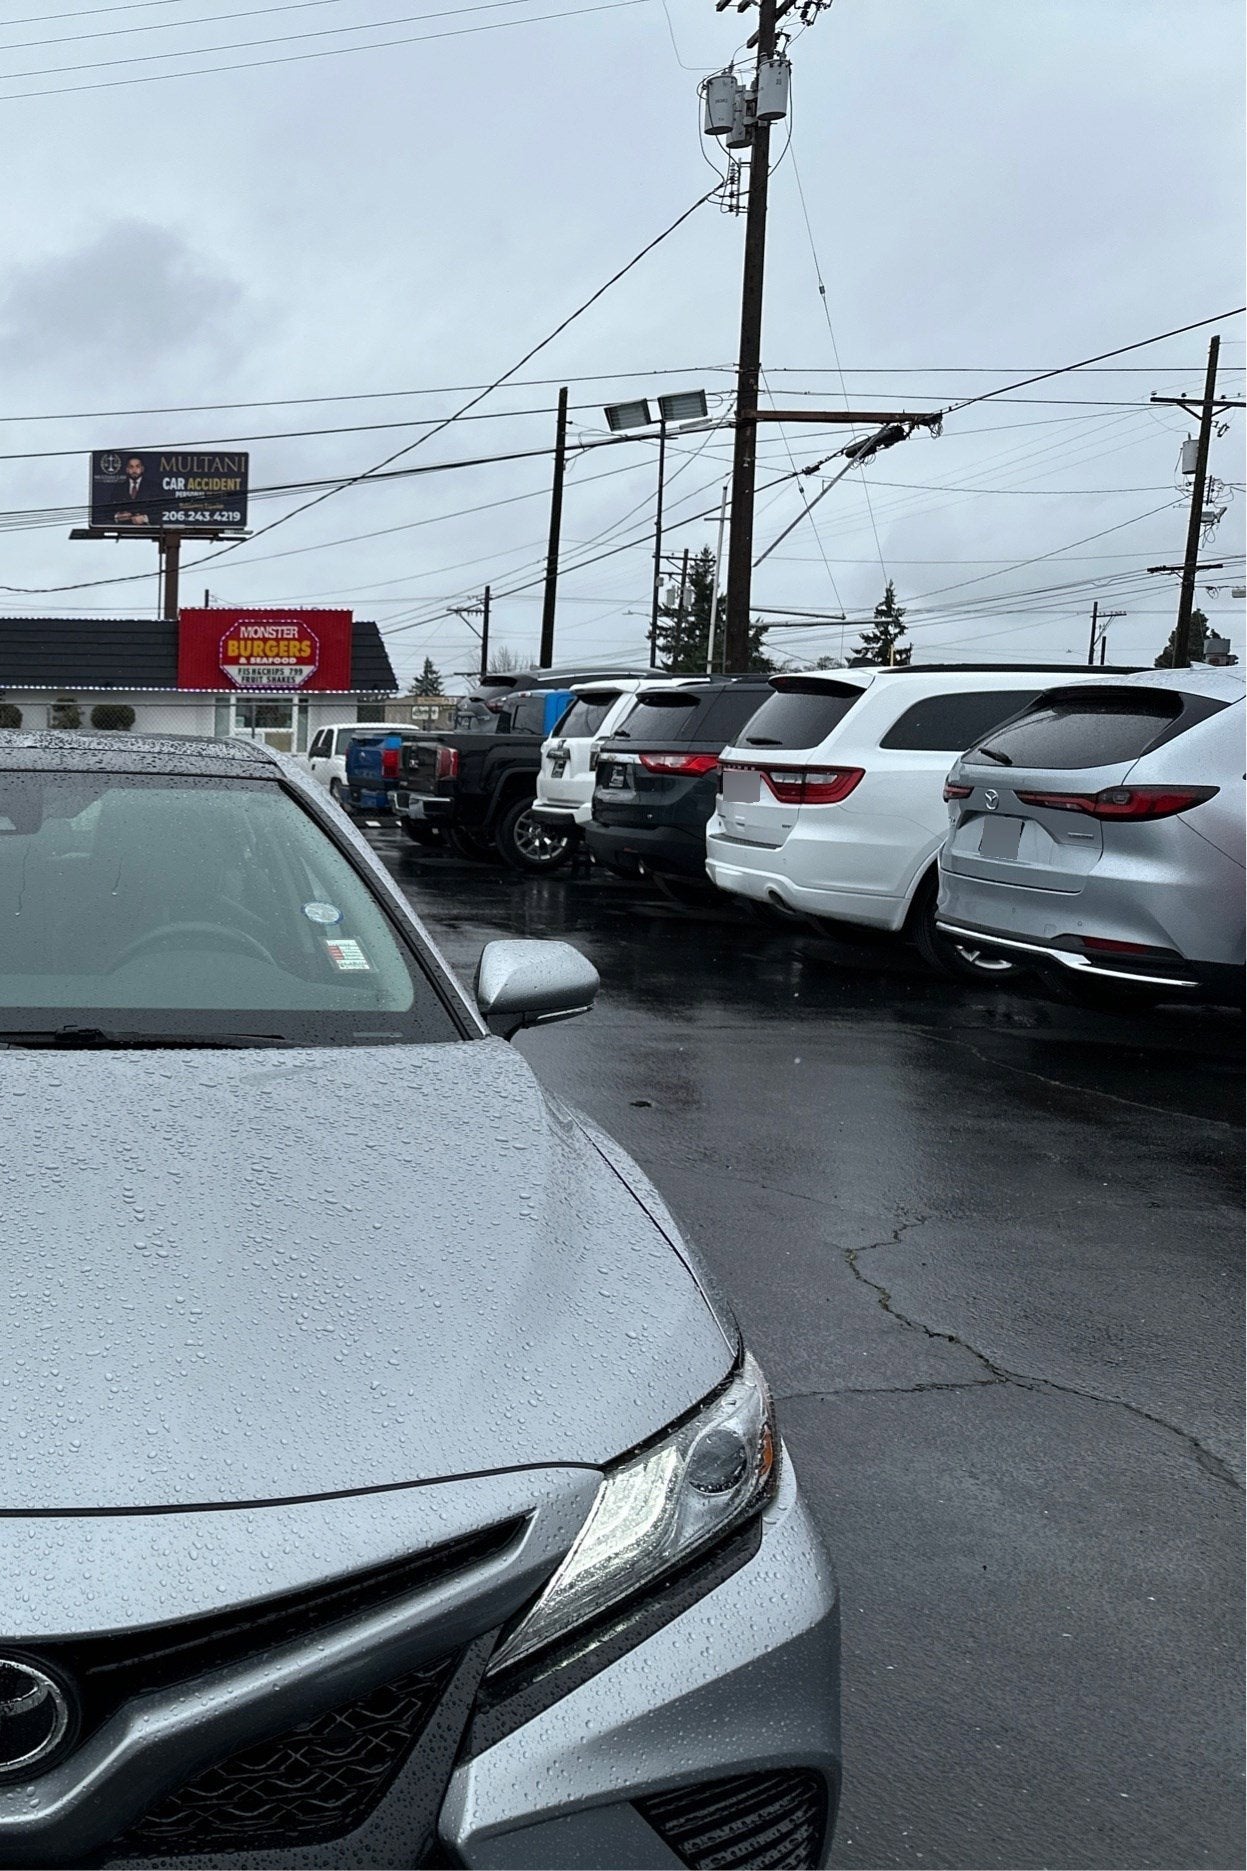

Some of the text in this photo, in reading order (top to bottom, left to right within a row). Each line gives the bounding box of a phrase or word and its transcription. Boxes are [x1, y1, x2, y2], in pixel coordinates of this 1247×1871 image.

[160, 457, 246, 472] MULTANI
[162, 477, 241, 491] CAR ACCIDENT
[162, 511, 241, 522] 206.243.4219
[240, 626, 298, 638] MONSTER
[227, 640, 311, 657] BURGERS
